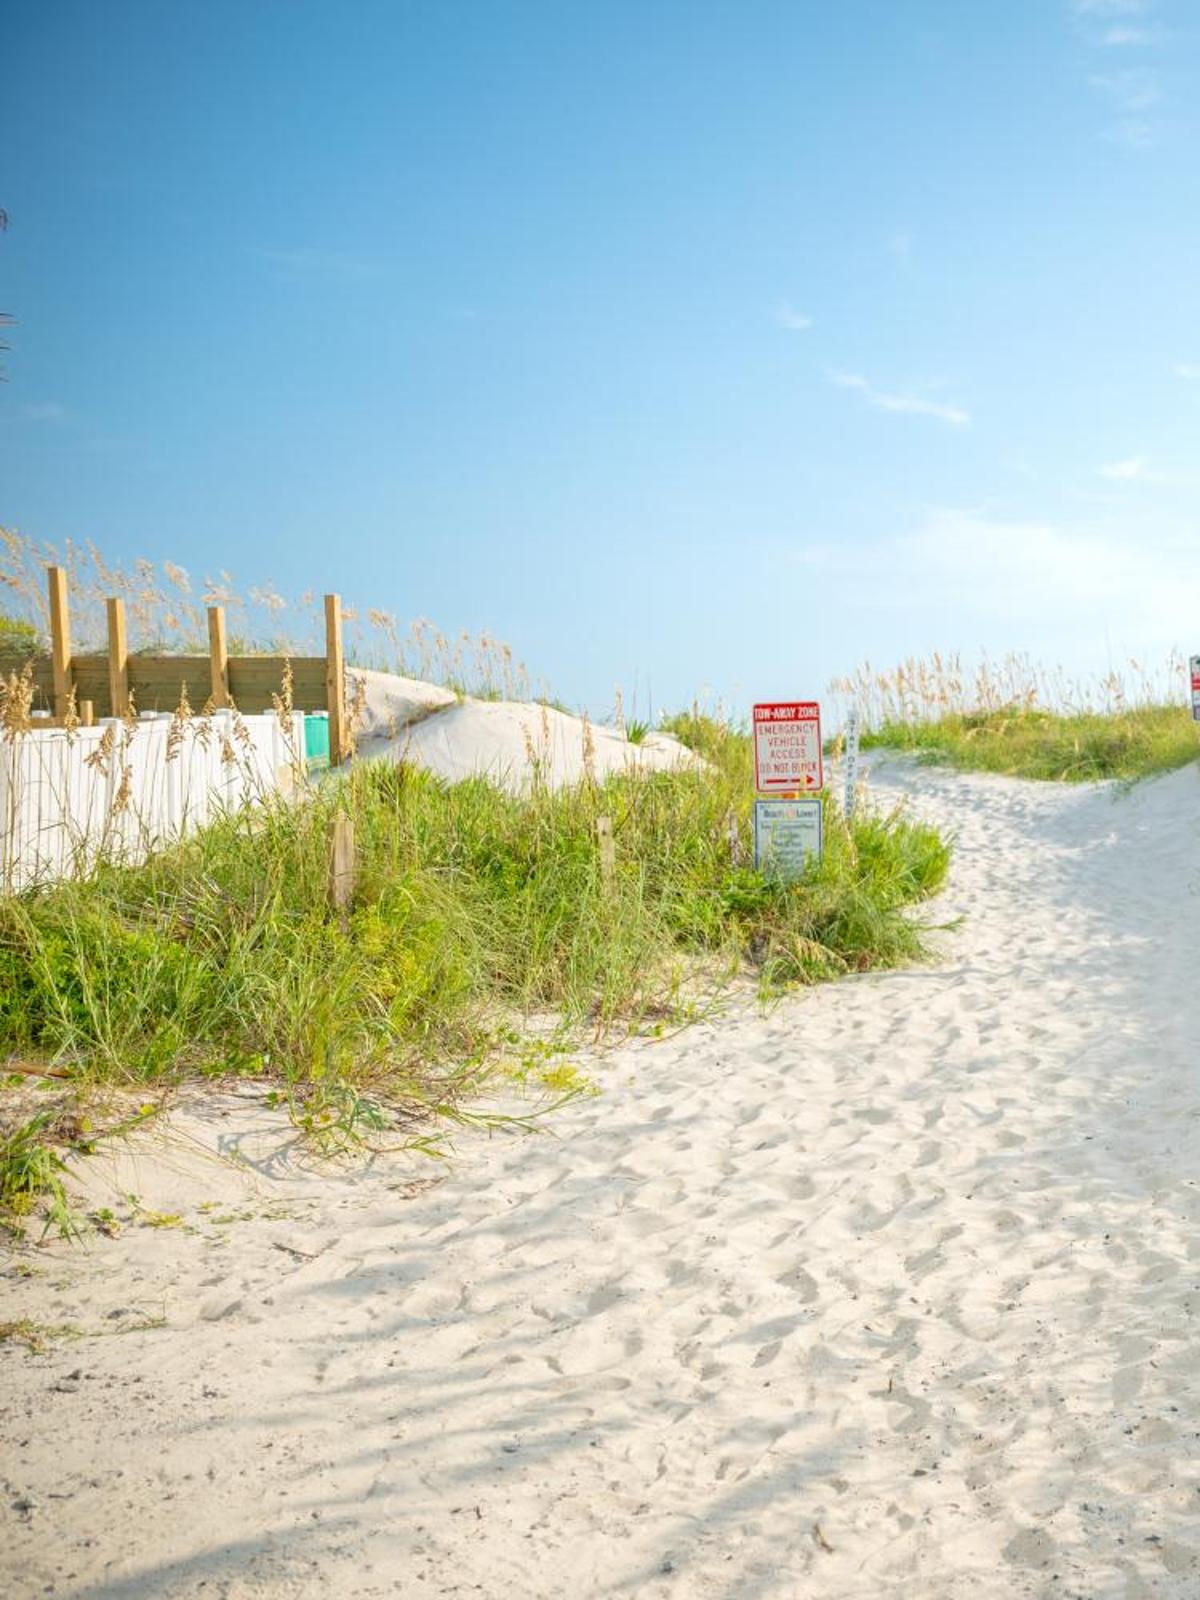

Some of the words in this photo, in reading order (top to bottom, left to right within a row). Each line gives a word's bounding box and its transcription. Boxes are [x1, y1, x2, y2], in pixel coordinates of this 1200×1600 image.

[755, 707, 796, 719] TOW-AWAY
[797, 706, 819, 718] ZONE
[759, 723, 815, 735] EMERGENCY
[767, 736, 807, 747] VEHICLE
[770, 748, 806, 759] ACCESS
[774, 762, 788, 773] NOT
